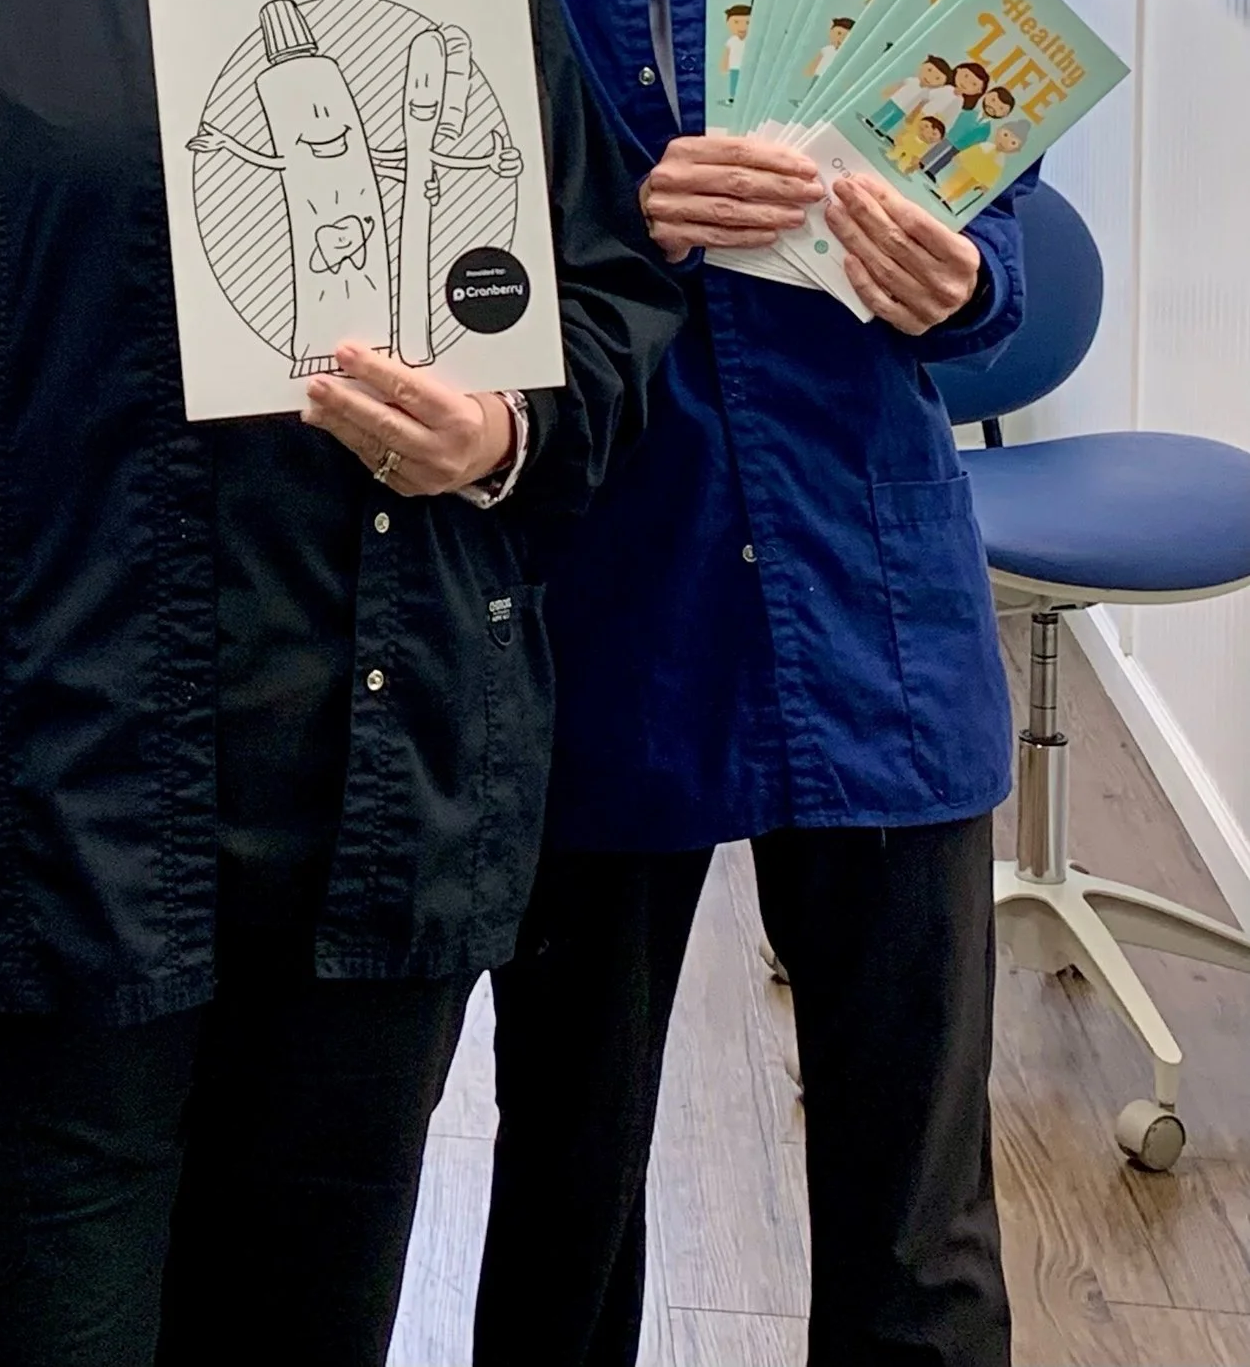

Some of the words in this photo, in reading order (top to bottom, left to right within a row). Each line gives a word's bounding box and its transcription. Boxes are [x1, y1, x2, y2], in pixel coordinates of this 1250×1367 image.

[966, 11, 1068, 126] LIFE
[831, 157, 853, 180] Ora
[465, 283, 524, 298] Cranberry
